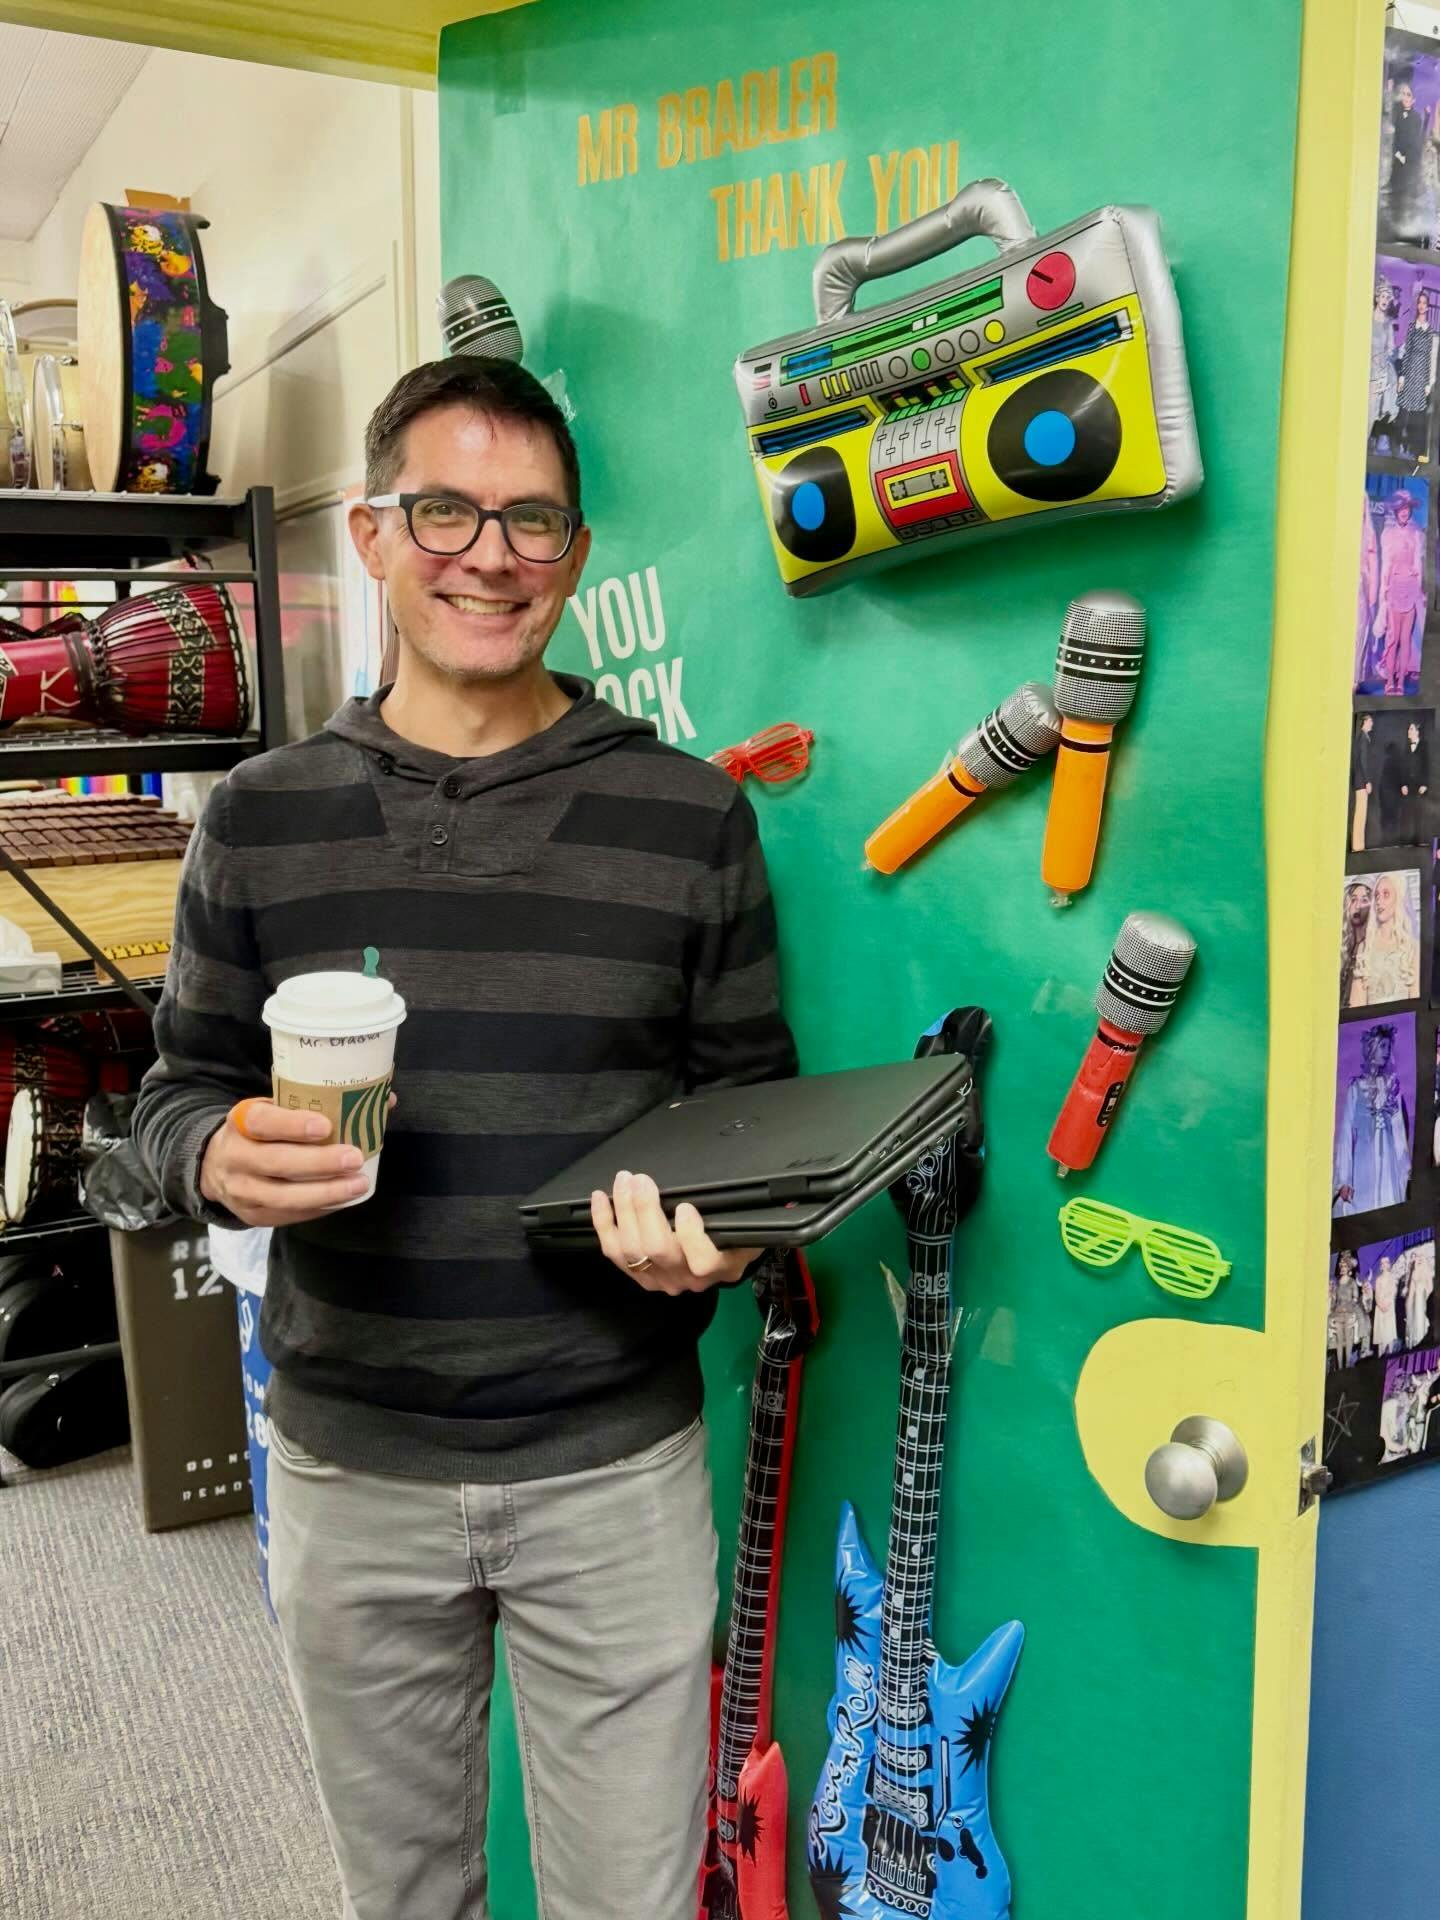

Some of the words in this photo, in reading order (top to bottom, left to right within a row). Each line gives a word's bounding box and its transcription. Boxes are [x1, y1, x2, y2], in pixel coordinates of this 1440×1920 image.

[578, 104, 638, 187] MR
[658, 52, 838, 169] BRADLER
[709, 160, 848, 263] THANK
[868, 141, 960, 236] YOU
[566, 566, 666, 670] YOU
[186, 1458, 213, 1473] DO
